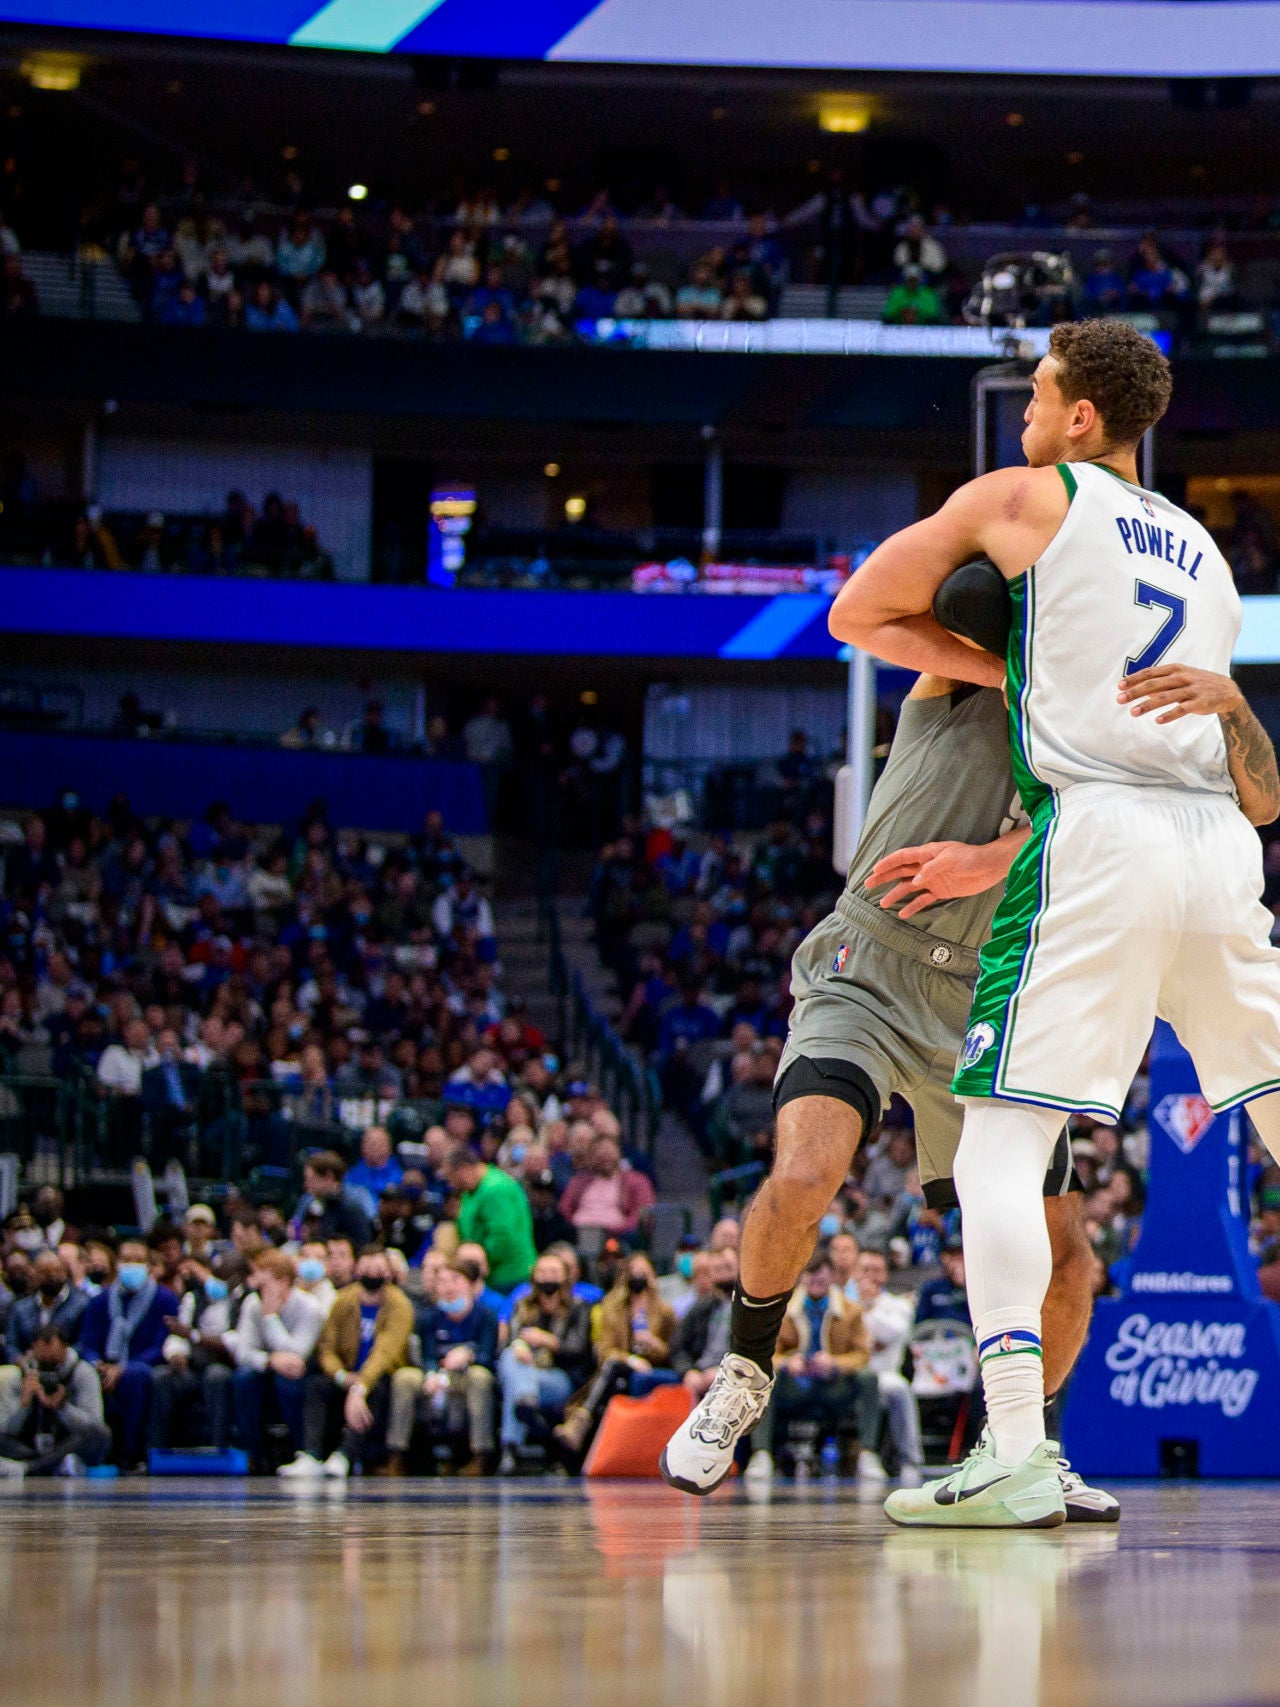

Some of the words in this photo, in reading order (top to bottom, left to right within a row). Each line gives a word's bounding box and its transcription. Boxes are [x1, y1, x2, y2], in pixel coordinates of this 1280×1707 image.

[1116, 517, 1203, 581] POWELL
[1123, 578, 1187, 678] 7
[1105, 1313, 1245, 1372] Season
[1110, 1369, 1140, 1407] of
[1140, 1356, 1259, 1417] Giving
